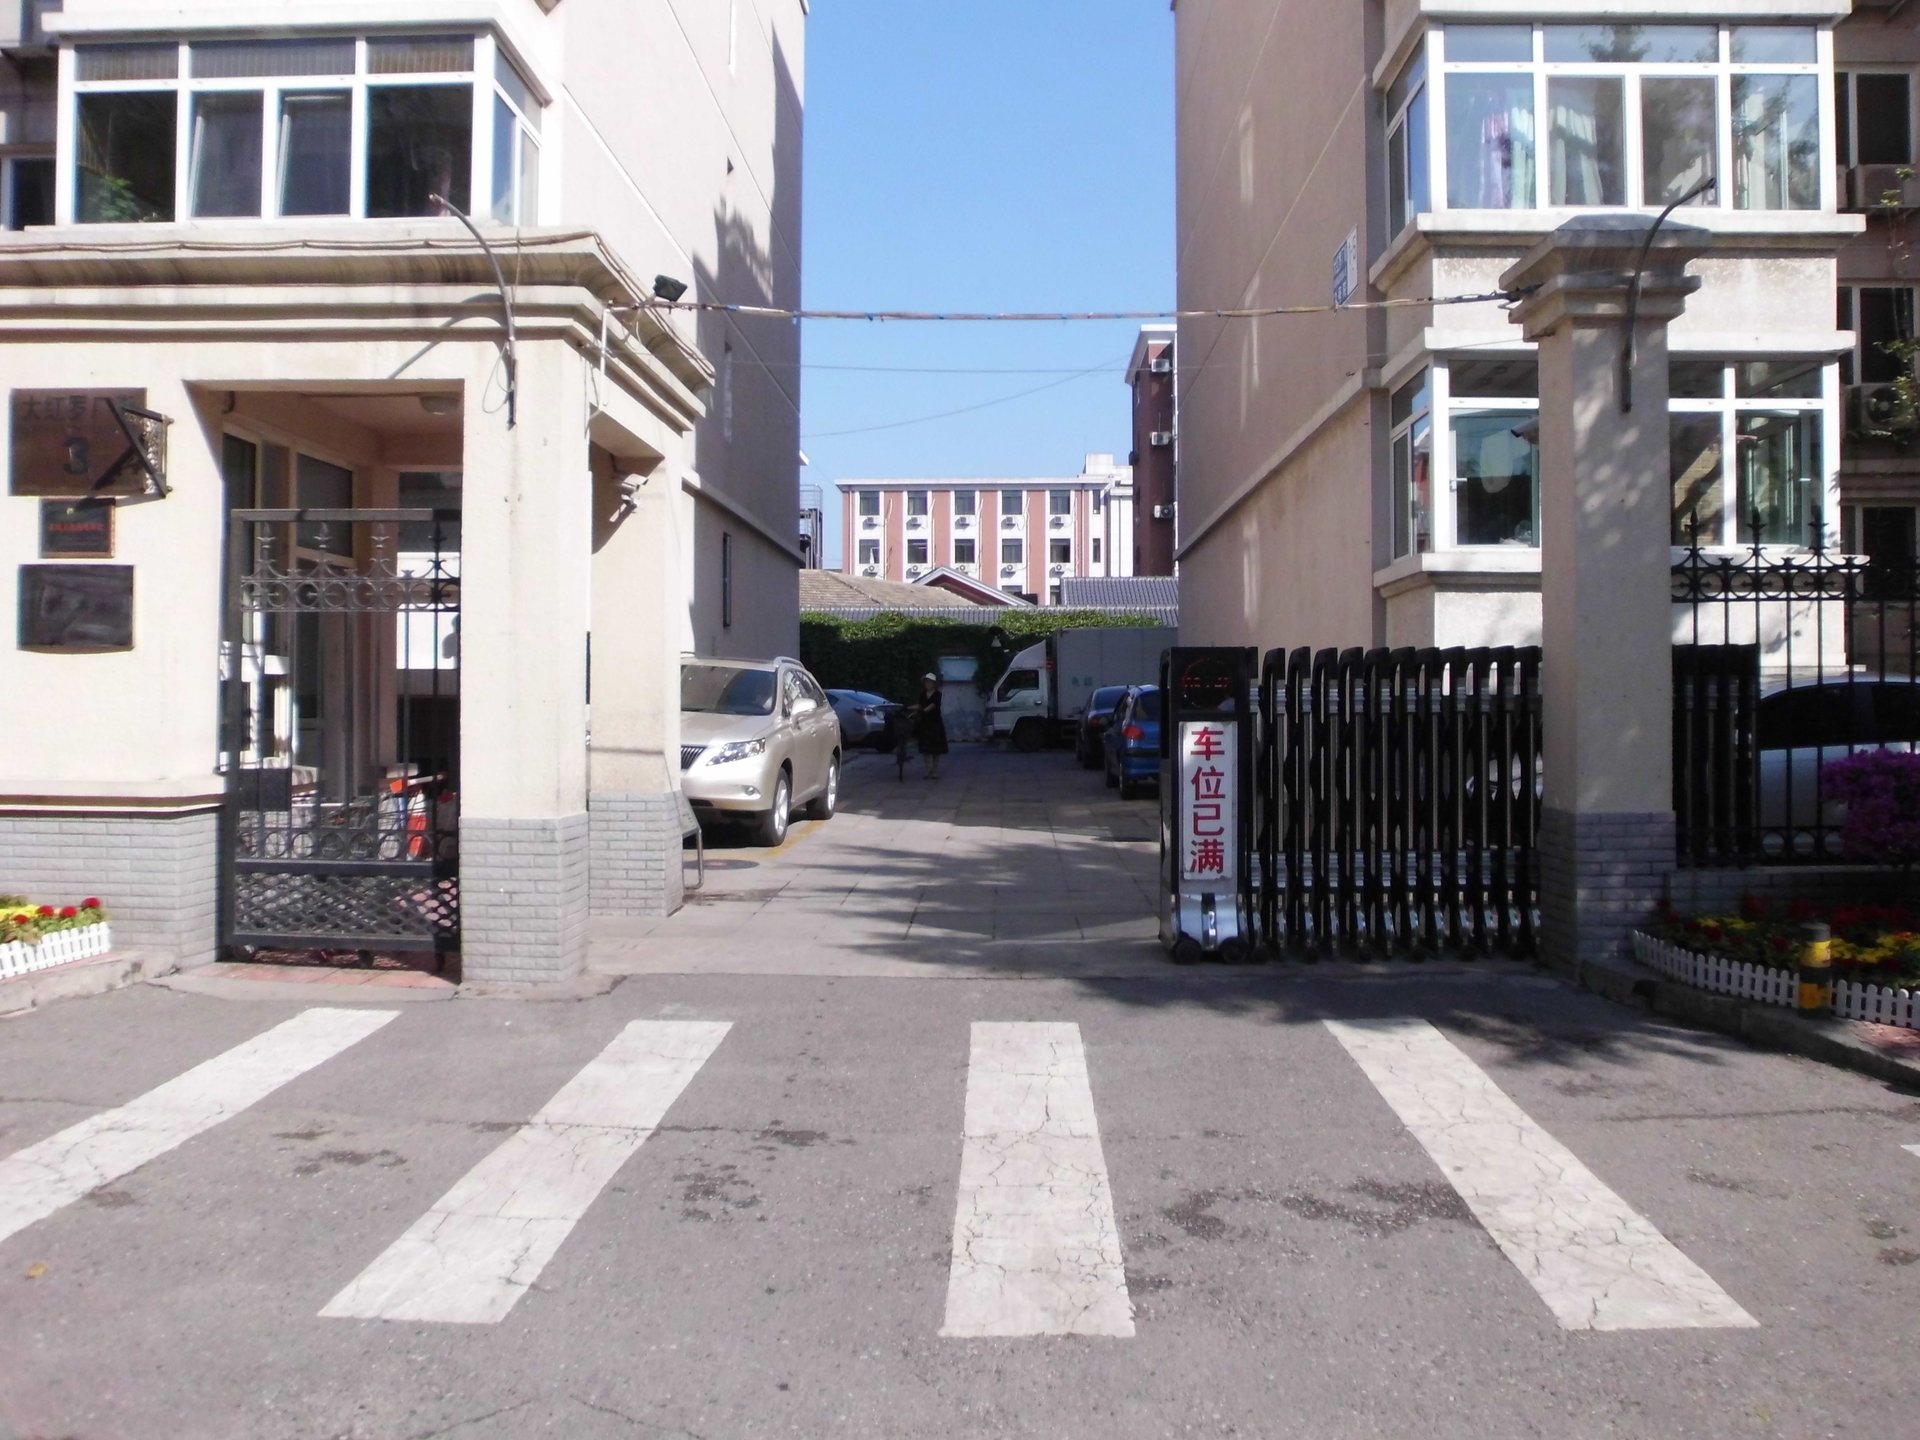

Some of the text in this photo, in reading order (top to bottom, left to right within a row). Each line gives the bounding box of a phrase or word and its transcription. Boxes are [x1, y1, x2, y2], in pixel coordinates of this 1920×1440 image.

[64, 437, 90, 474] 3
[1190, 726, 1226, 875] 车位已满
